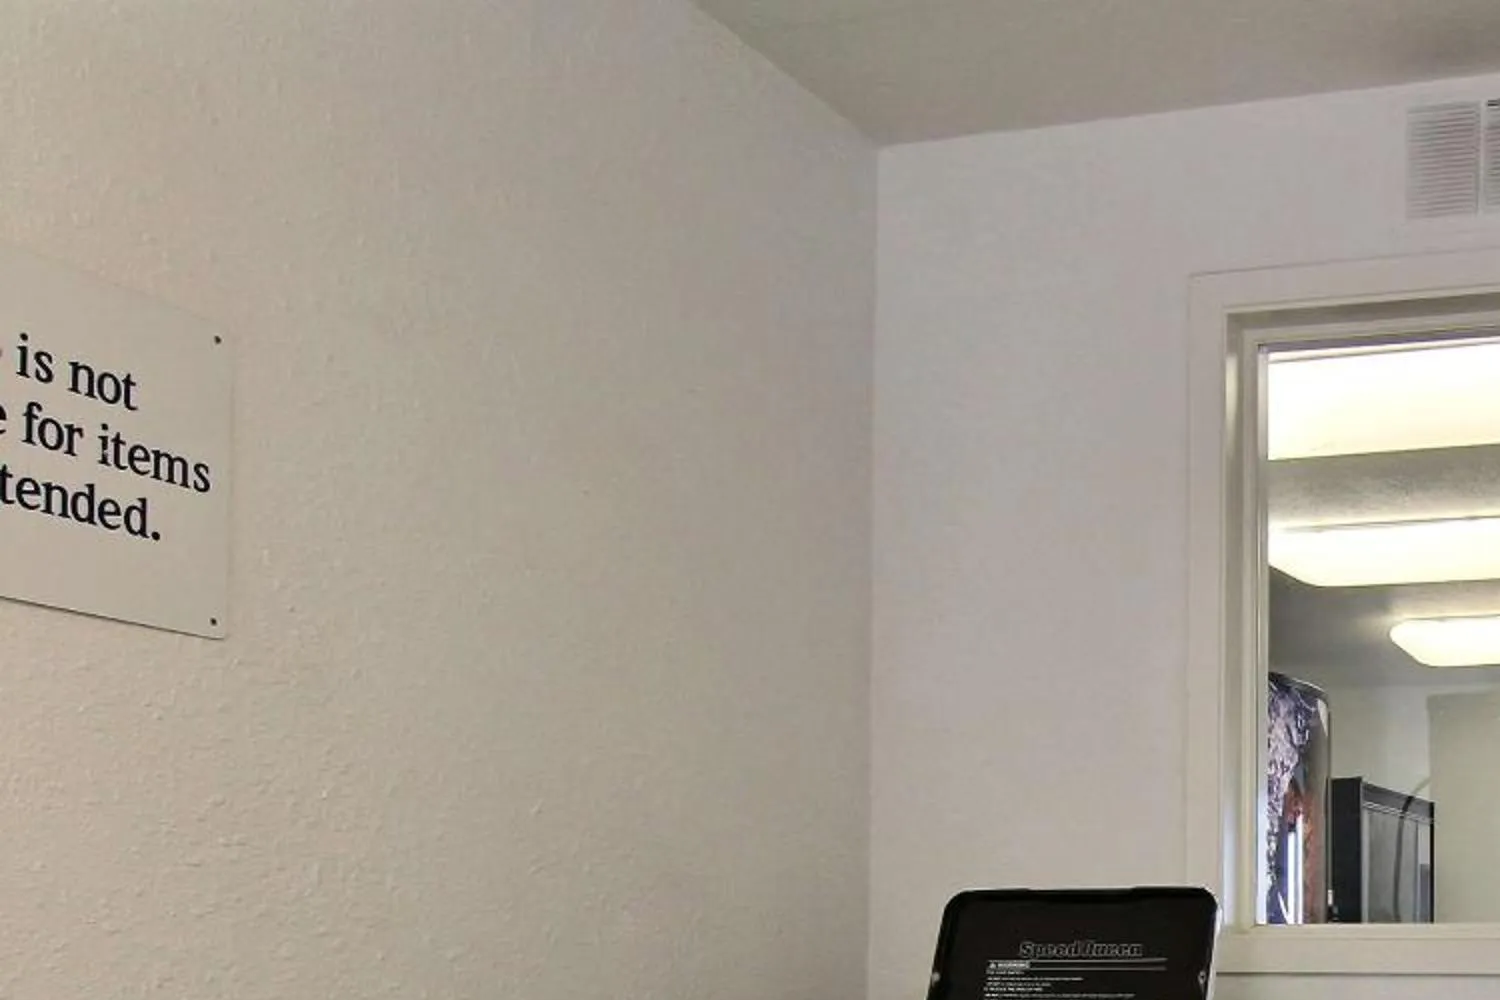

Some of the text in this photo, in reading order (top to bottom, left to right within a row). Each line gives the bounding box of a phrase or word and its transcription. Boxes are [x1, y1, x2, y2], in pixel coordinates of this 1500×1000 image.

[16, 333, 138, 411] is not
[21, 401, 84, 457] for
[98, 424, 211, 493] items
